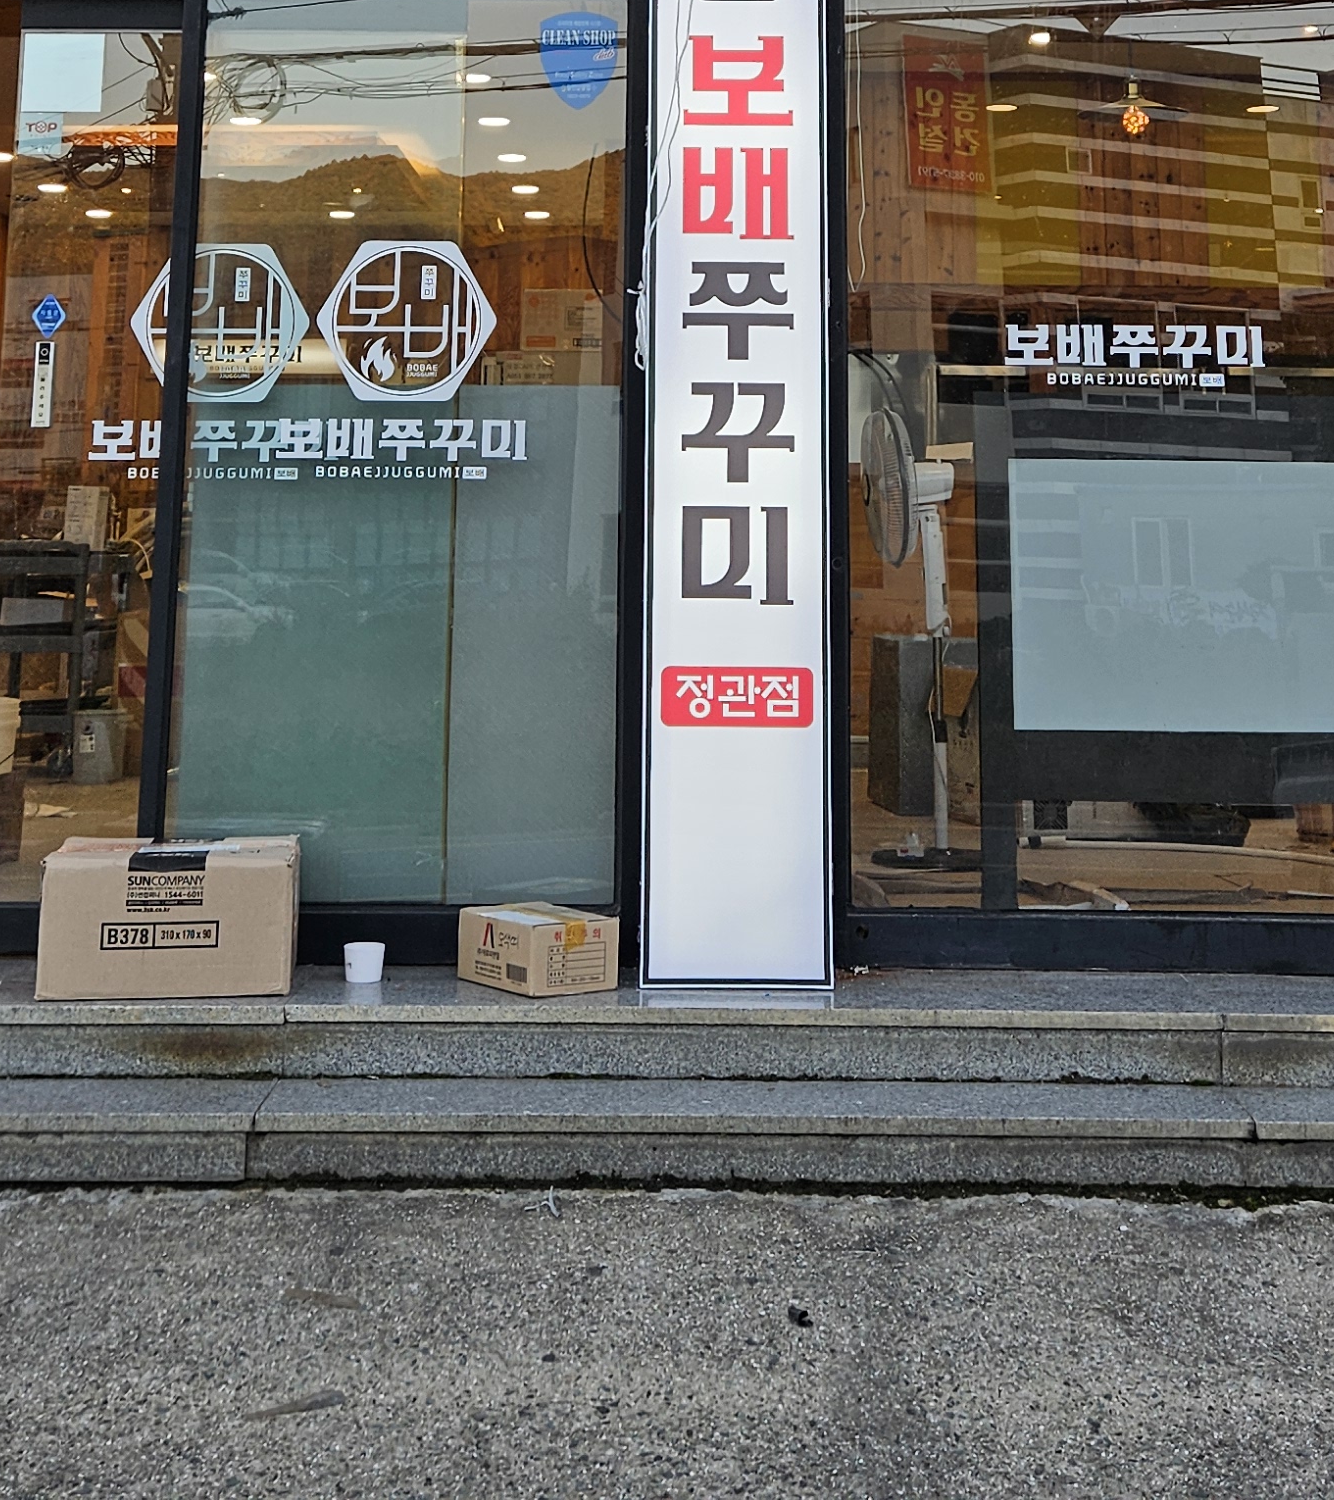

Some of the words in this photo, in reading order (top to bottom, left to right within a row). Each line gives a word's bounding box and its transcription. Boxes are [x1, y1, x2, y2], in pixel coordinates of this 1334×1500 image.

[542, 29, 580, 46] CLEAN
[583, 29, 616, 46] SHOP
[681, 33, 796, 607] 보배쭈꾸미
[1003, 323, 1266, 369] 보배쭈꾸미
[406, 363, 439, 372] BOBAE
[1046, 373, 1198, 387] BOBAEJJUGGUMI
[275, 417, 528, 462] 보배쭈꾸미
[315, 466, 460, 479] BOBAEJJUGGUMI
[674, 674, 801, 720] 정관점
[127, 874, 206, 887] SUNCOMPANY
[164, 891, 204, 899] 1544-6011
[107, 928, 149, 945] B378
